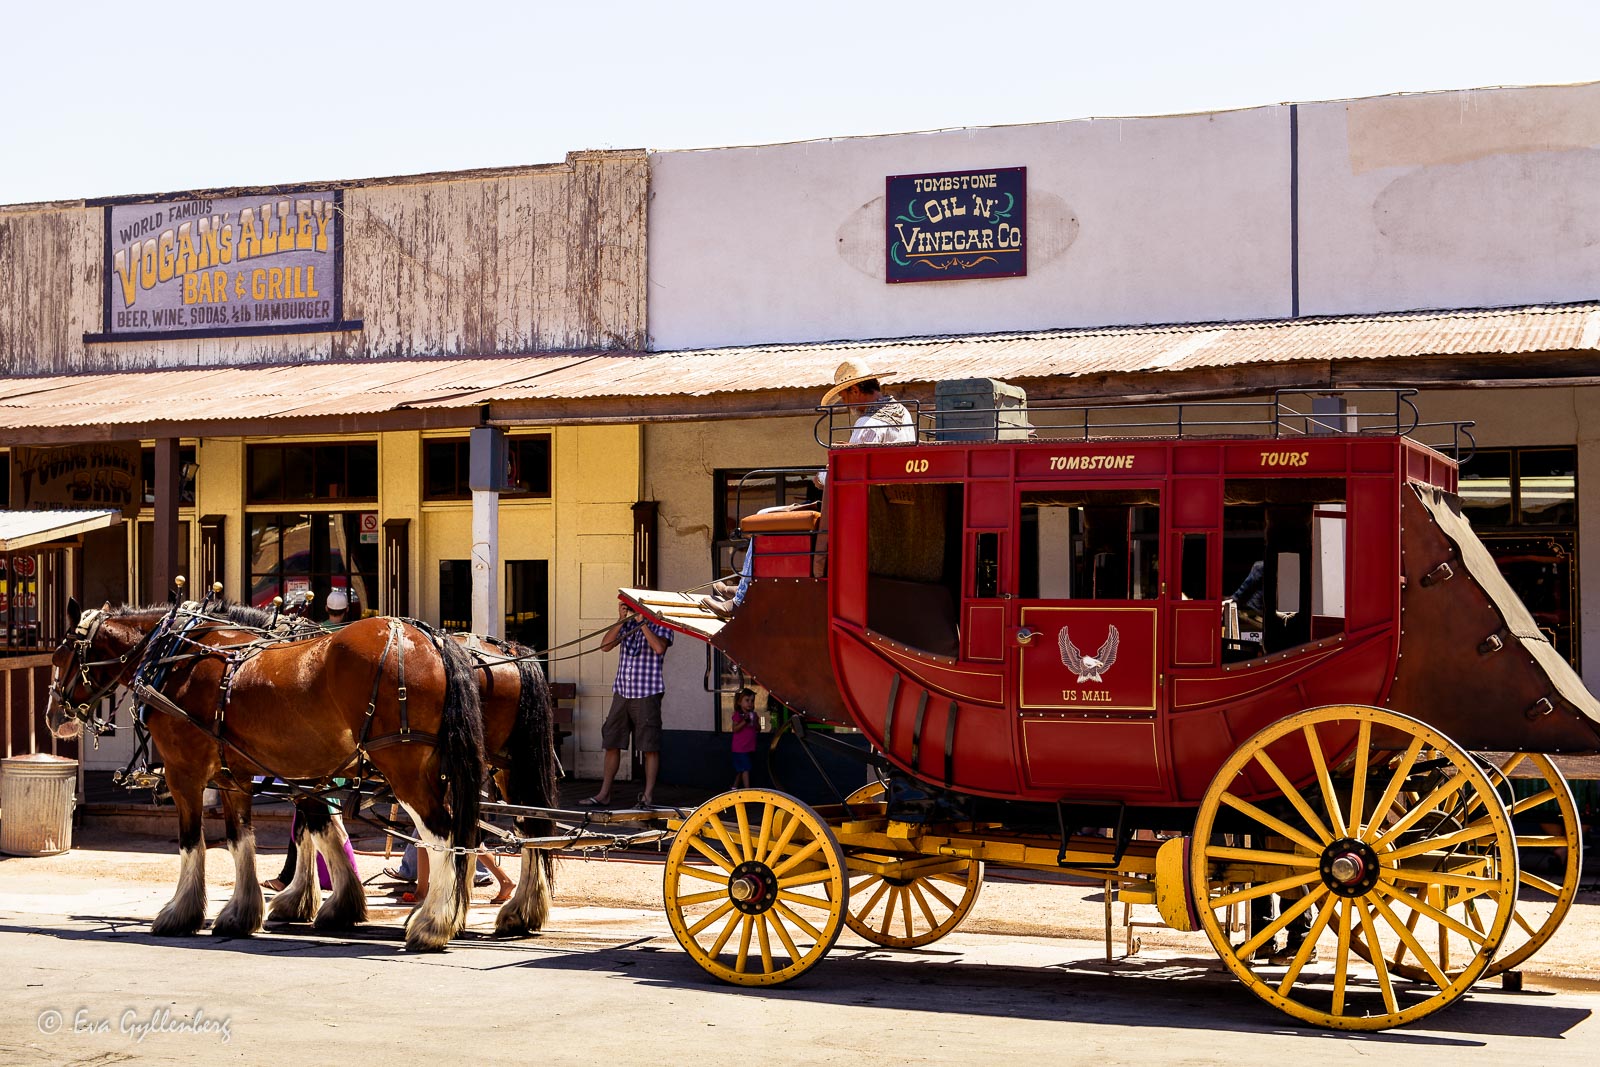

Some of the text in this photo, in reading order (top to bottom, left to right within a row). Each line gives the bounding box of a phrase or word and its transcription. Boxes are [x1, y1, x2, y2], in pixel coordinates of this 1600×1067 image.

[914, 174, 997, 192] TOMBSTONE
[120, 199, 213, 244] WORLD FAMOUS
[924, 196, 966, 223] OIL
[237, 199, 333, 262] ALLEY
[894, 223, 993, 253] VINEGAR
[181, 265, 319, 306] BAR & GRILL
[117, 309, 151, 329] BEER,
[152, 307, 188, 327] WINE,
[191, 305, 229, 325] SODAS,
[255, 300, 330, 322] HAMBURGER
[905, 451, 1309, 473] OLD TOMBSTONE TOURS
[1062, 690, 1112, 701] US MAIL
